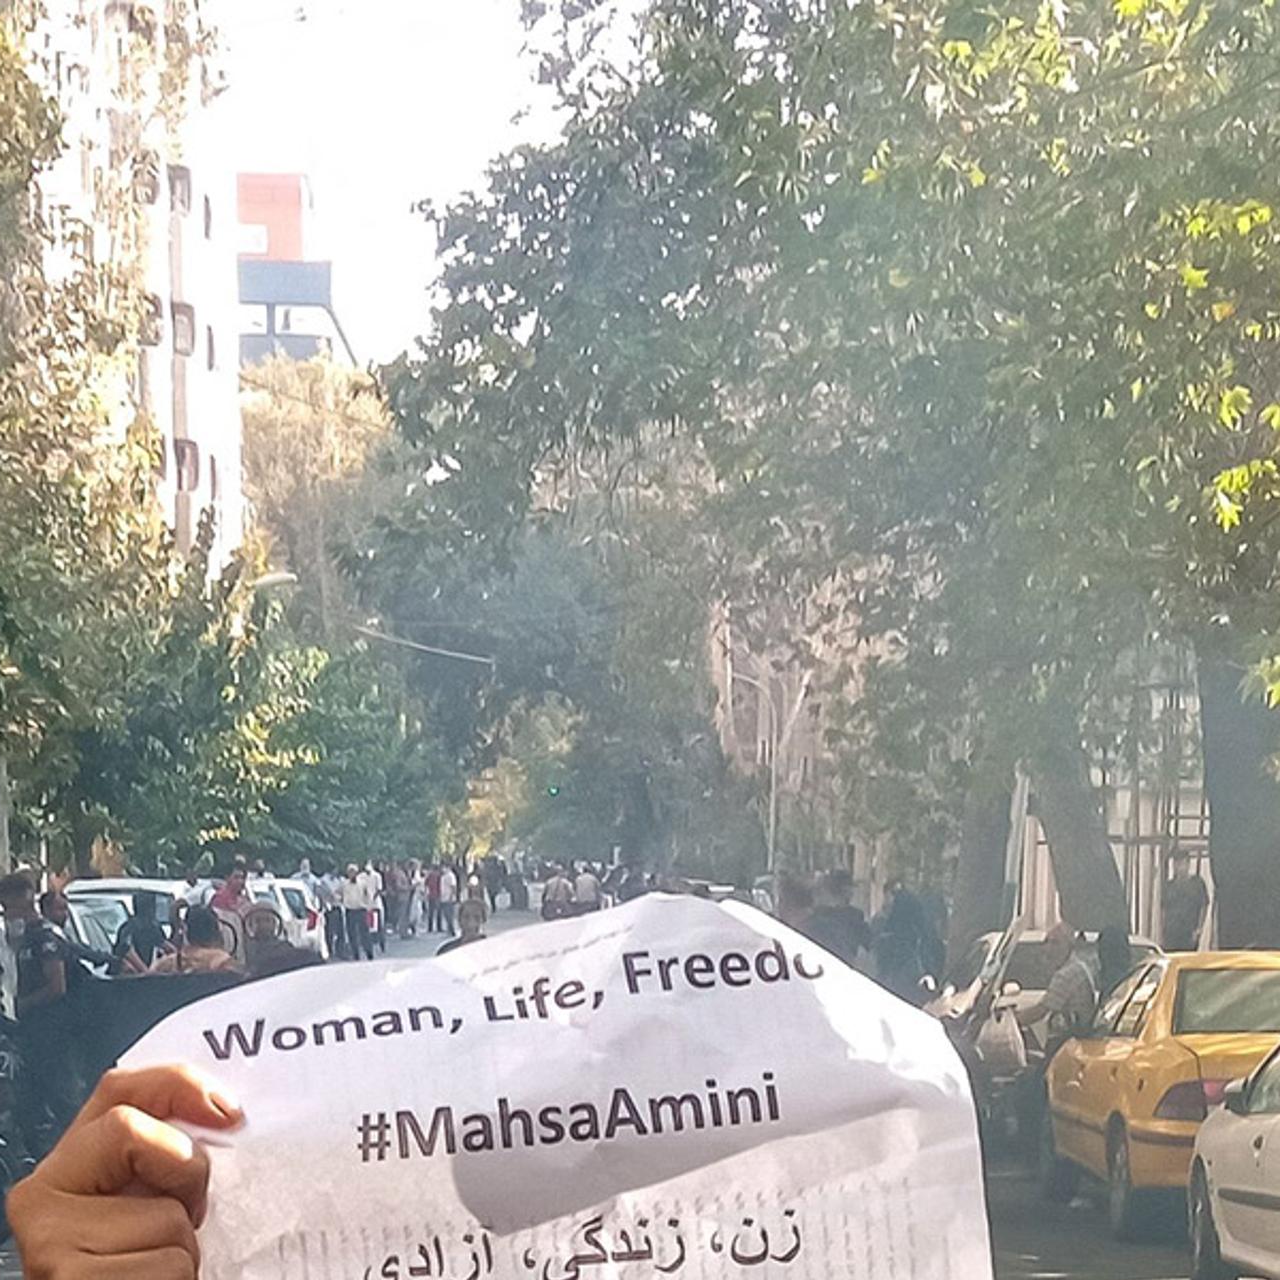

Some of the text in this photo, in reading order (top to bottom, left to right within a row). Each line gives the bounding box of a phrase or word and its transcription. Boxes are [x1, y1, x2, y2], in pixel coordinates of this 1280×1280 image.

[203, 1003, 463, 1061] Woman,
[484, 976, 605, 1023] Life,
[622, 939, 824, 996] Freedo
[357, 1072, 782, 1162] #MahsaAmini
[709, 1209, 803, 1266] زن،
